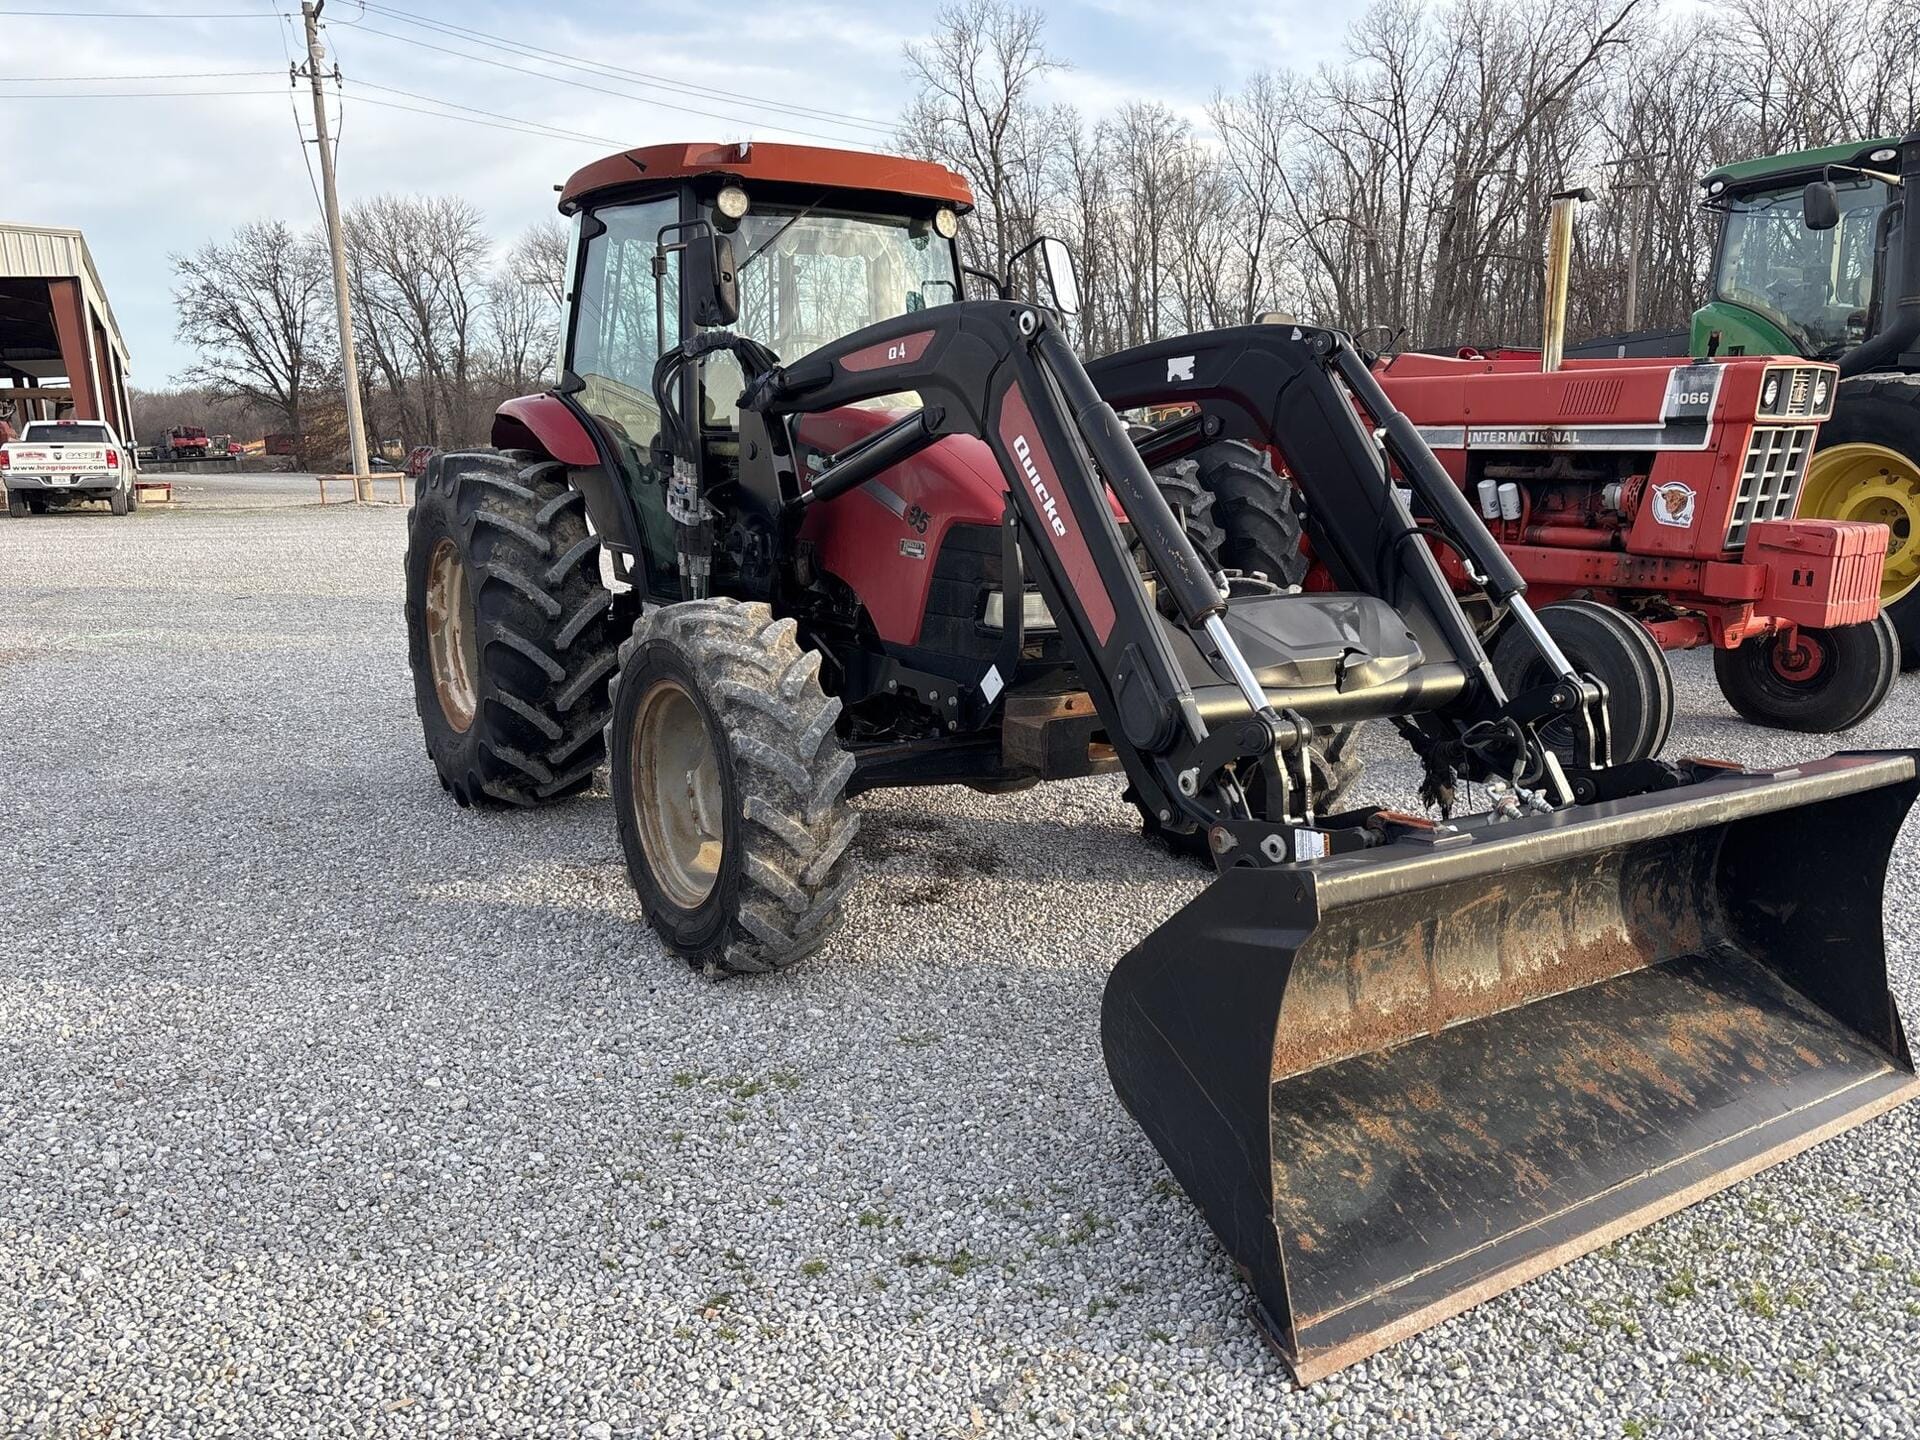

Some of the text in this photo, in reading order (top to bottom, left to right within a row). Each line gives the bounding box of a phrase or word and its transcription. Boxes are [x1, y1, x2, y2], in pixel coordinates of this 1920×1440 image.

[888, 341, 906, 360] Q4
[1670, 392, 1710, 405] 1066
[1467, 431, 1580, 444] INTERNATIONAL
[12, 464, 107, 472] www.hragripower.com
[1013, 434, 1067, 537] Quicke
